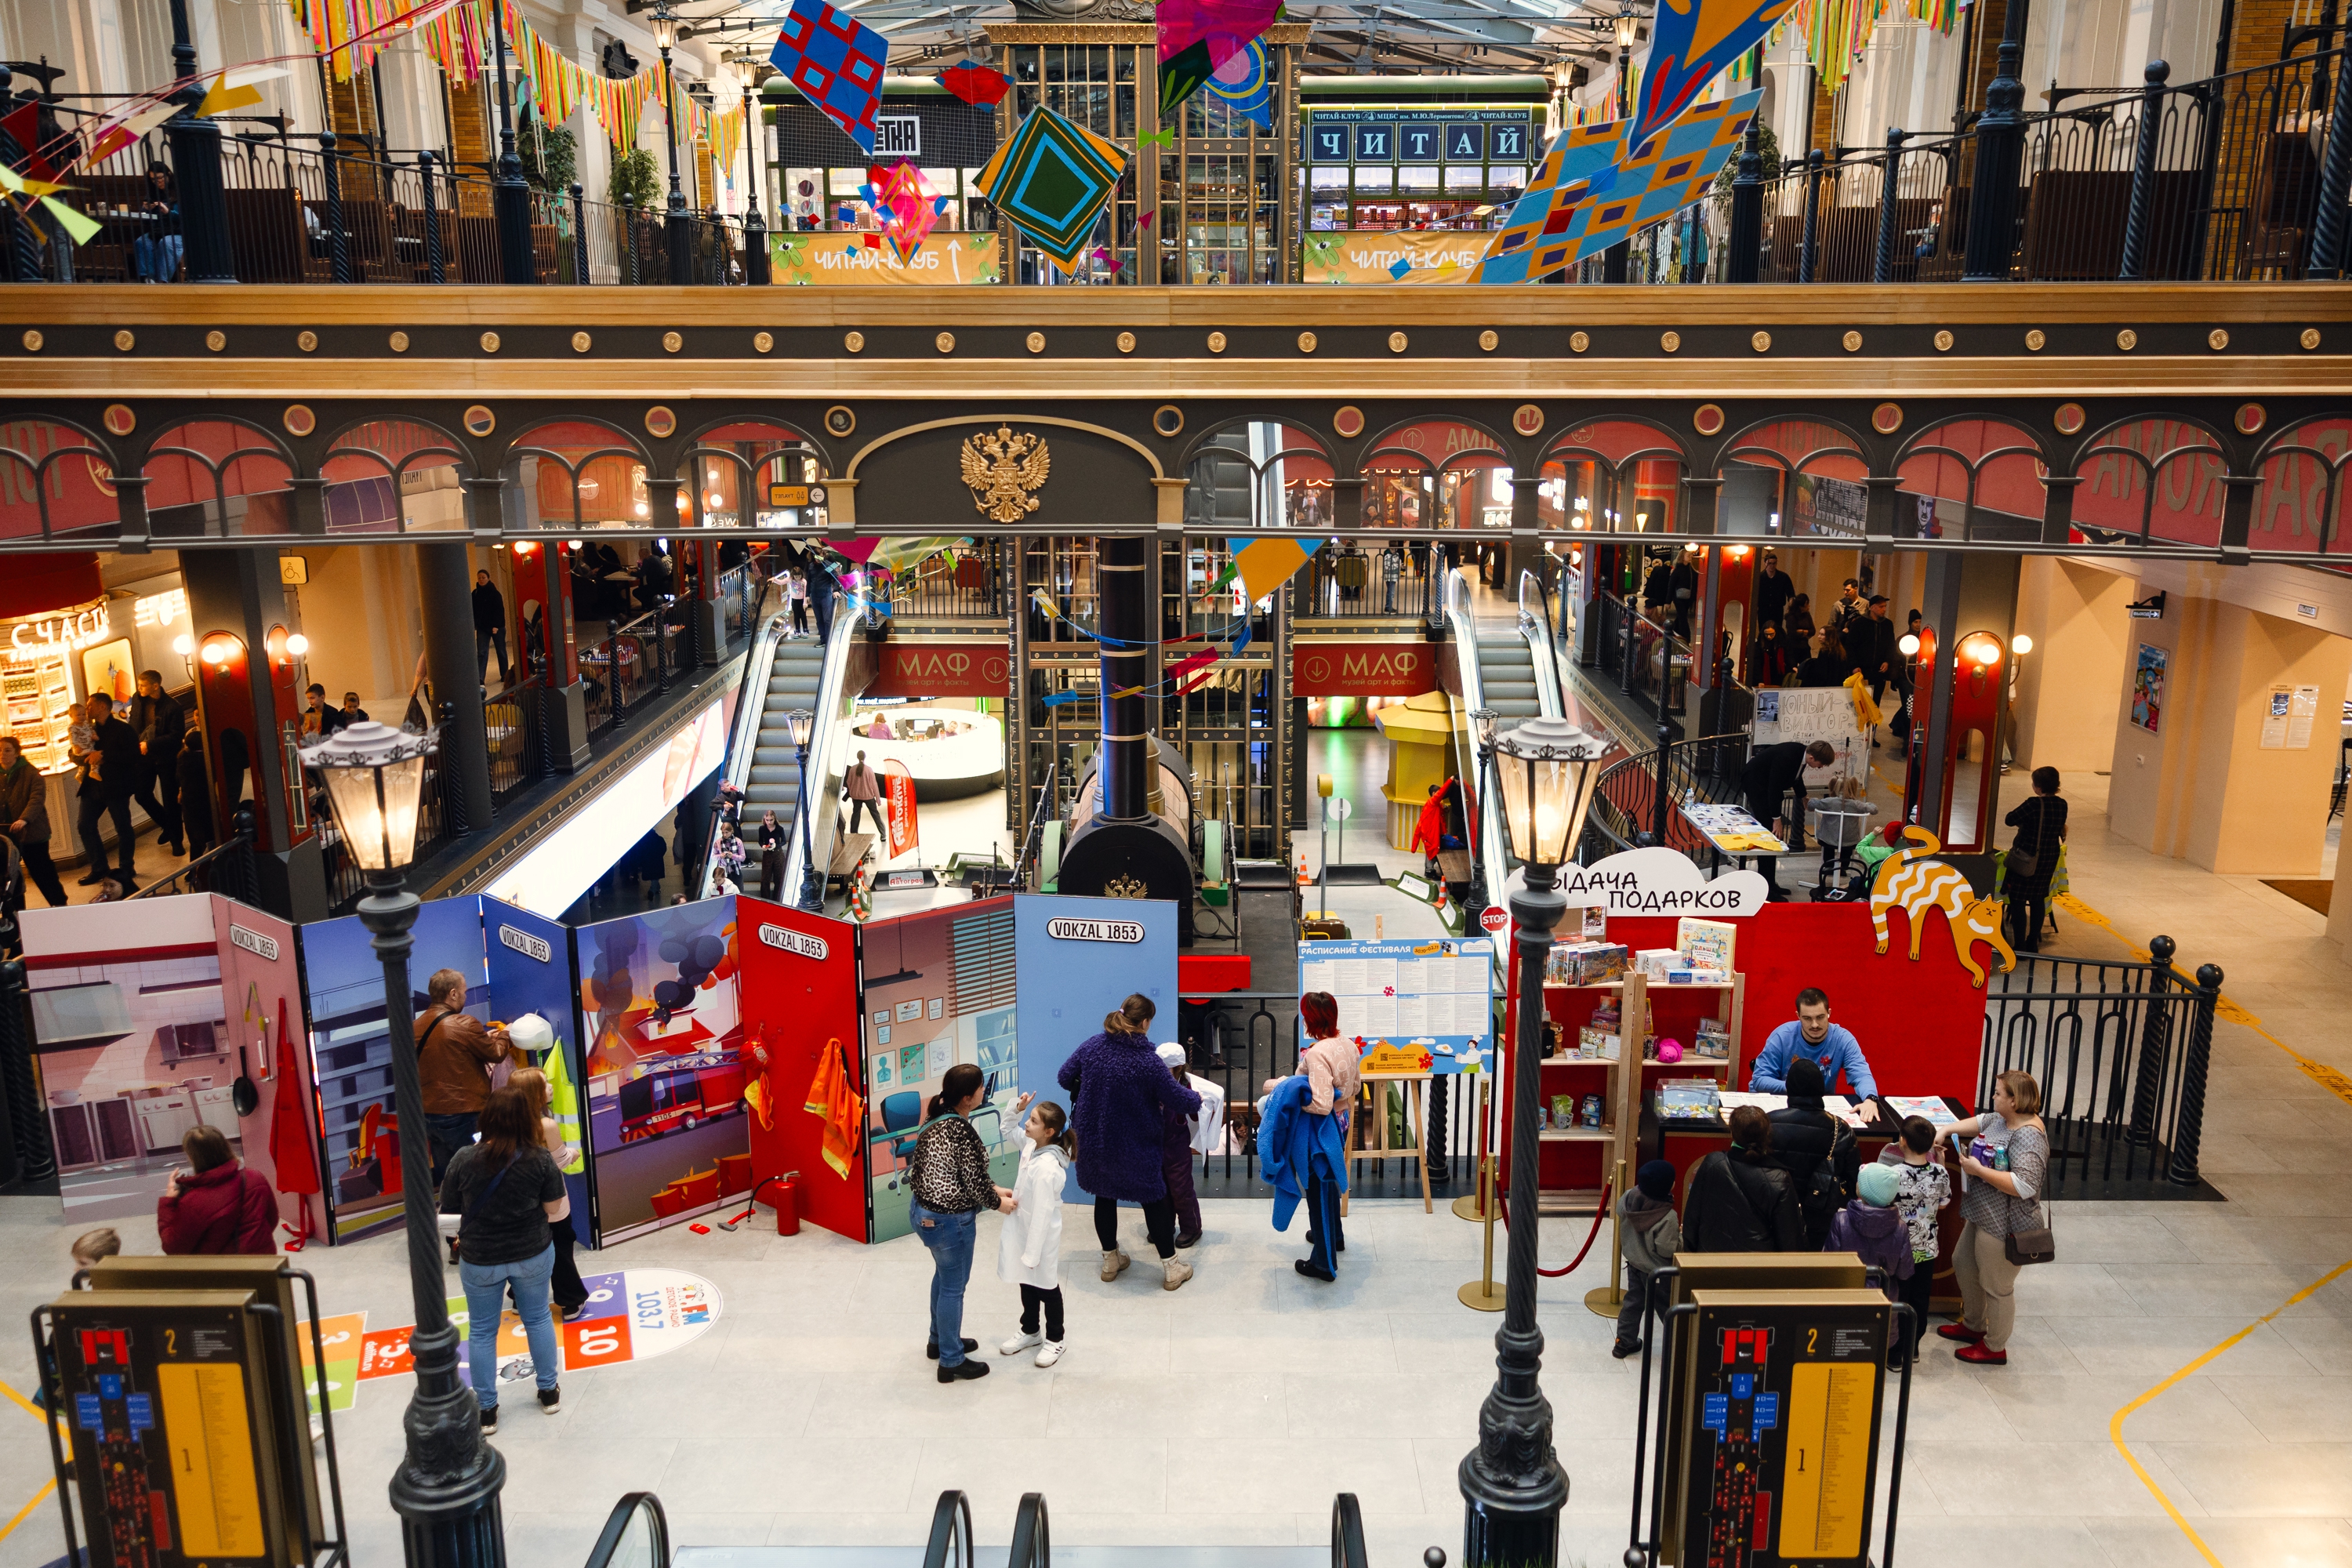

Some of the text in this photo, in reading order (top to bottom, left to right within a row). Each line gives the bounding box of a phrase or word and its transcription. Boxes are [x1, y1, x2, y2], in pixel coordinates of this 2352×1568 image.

[1320, 127, 1519, 155] ЧИТАЙ
[896, 652, 971, 677] МАФ
[1342, 652, 1418, 677] МАФ
[1341, 678, 1365, 687] музей
[1782, 691, 1834, 715] ЮНЫЙ
[1769, 713, 1849, 734] АВИАТОР
[1551, 872, 1638, 894] ЫДАЧА
[1610, 891, 1742, 912] ПОДАРКОВ
[1482, 913, 1507, 924] STOP
[232, 927, 275, 958] VOKZAL 1853
[763, 927, 823, 958] VOKZAL 1853
[1054, 921, 1137, 942] VOKZAL 1853
[502, 928, 547, 960] VOKZAL 1853
[1301, 946, 1411, 955] РАСПИСАНИЕ ФЕСТИВАЛЯ
[1414, 945, 1439, 954] 30.10-02.11
[636, 1290, 665, 1330] 103.7
[666, 1287, 681, 1328] ДЕТСКОЕ РАДИО
[681, 1303, 710, 1326] FM
[165, 1329, 177, 1355] 2
[579, 1325, 619, 1356] 10
[1807, 1328, 1818, 1353] 2
[181, 1448, 193, 1472] 1
[1797, 1448, 1806, 1472] 1
